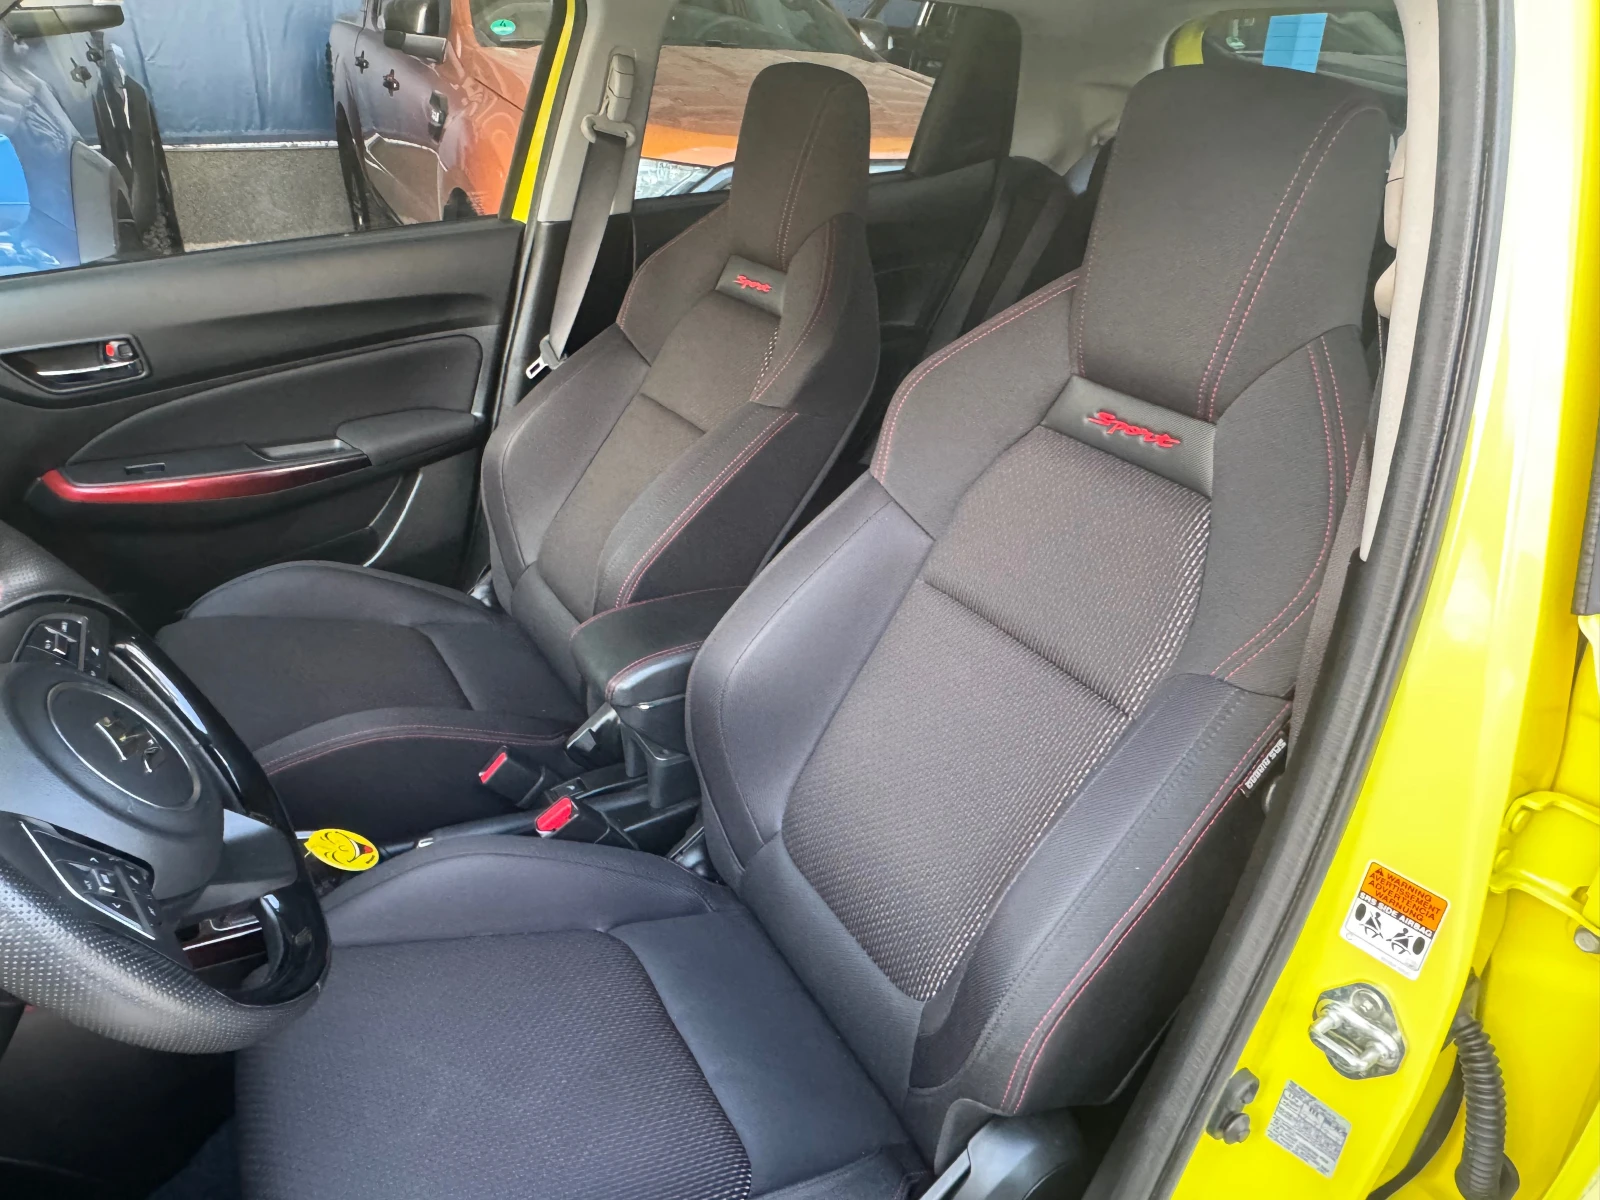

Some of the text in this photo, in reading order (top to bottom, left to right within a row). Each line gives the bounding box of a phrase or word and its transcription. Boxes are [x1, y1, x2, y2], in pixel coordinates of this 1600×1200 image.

[733, 274, 772, 293] Sport
[1087, 411, 1181, 448] Sport
[1368, 880, 1435, 920] ADVERTENCIA
[1369, 873, 1440, 914] AVERTISSEMENT
[1375, 890, 1423, 921] WARNUNG
[1387, 873, 1432, 902] WARNING
[1359, 891, 1433, 938] SRS SIDE AIRBAG
